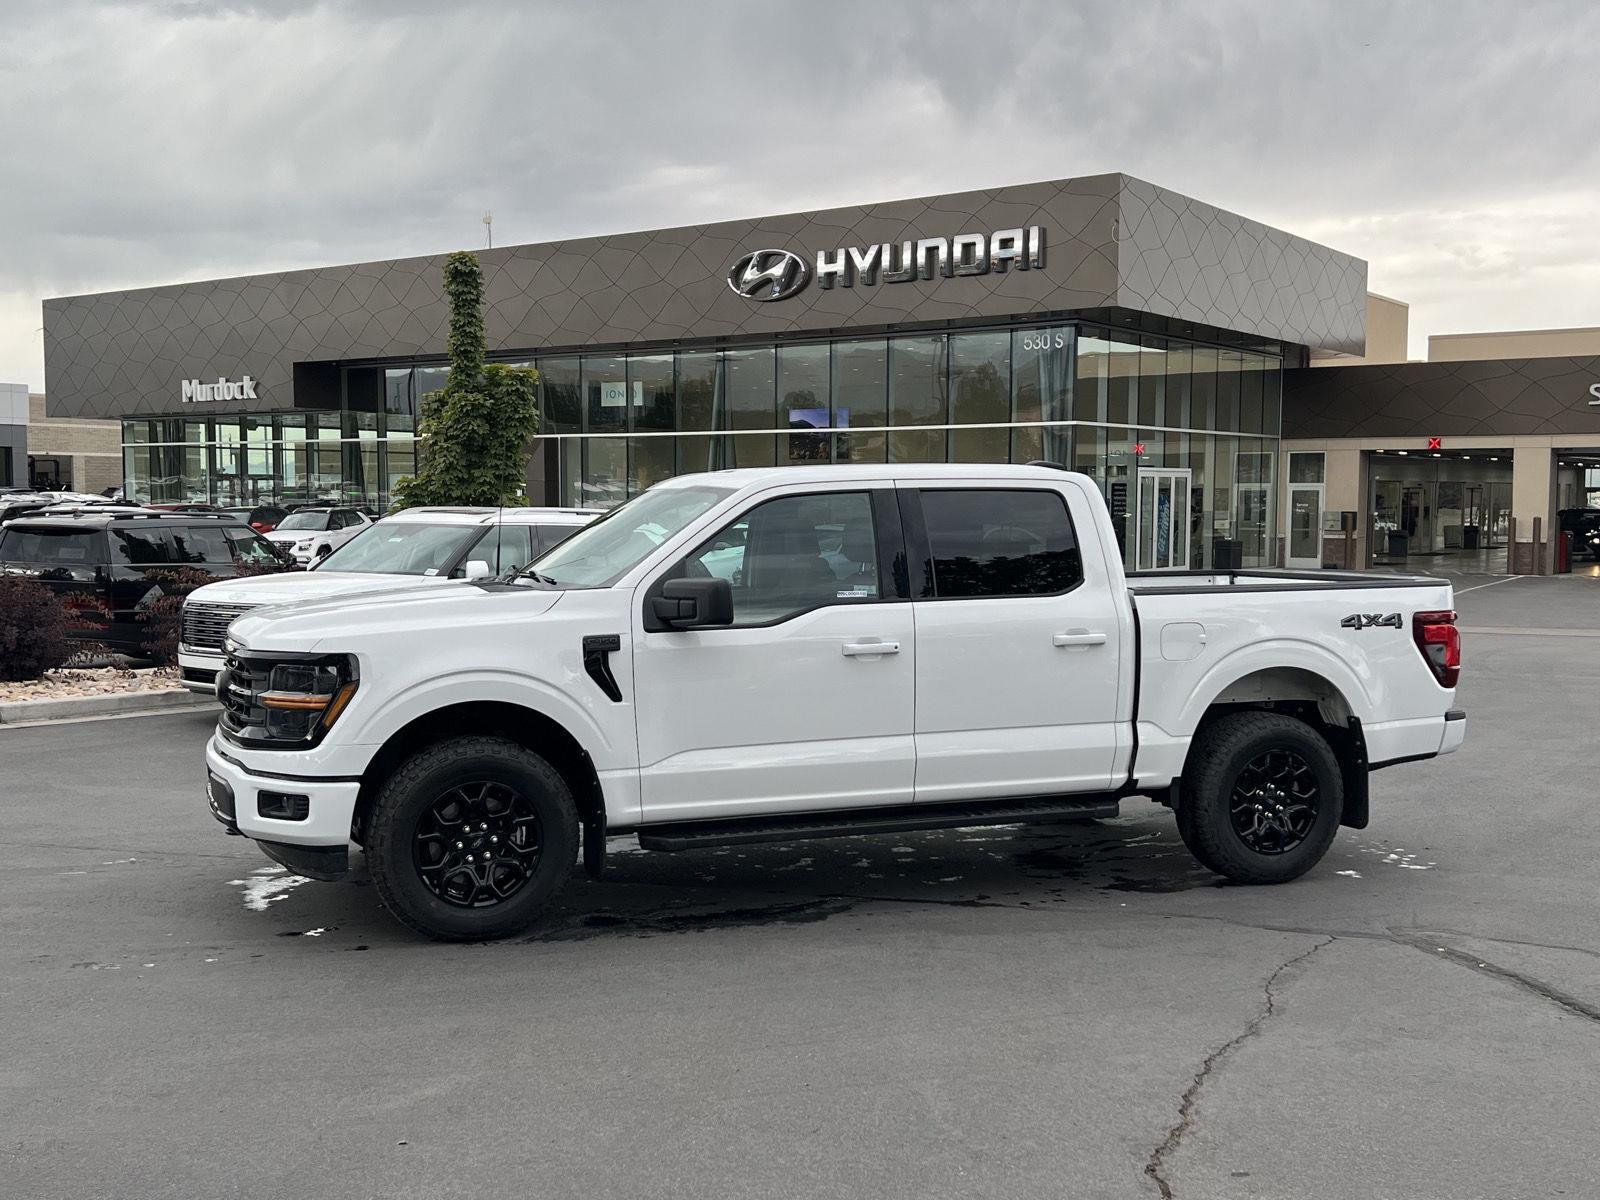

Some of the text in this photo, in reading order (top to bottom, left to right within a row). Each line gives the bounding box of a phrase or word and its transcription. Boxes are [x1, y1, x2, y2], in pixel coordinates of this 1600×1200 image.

[816, 225, 1046, 289] HYUNDAI
[1023, 332, 1064, 350] 530 S
[181, 375, 257, 403] Murdock
